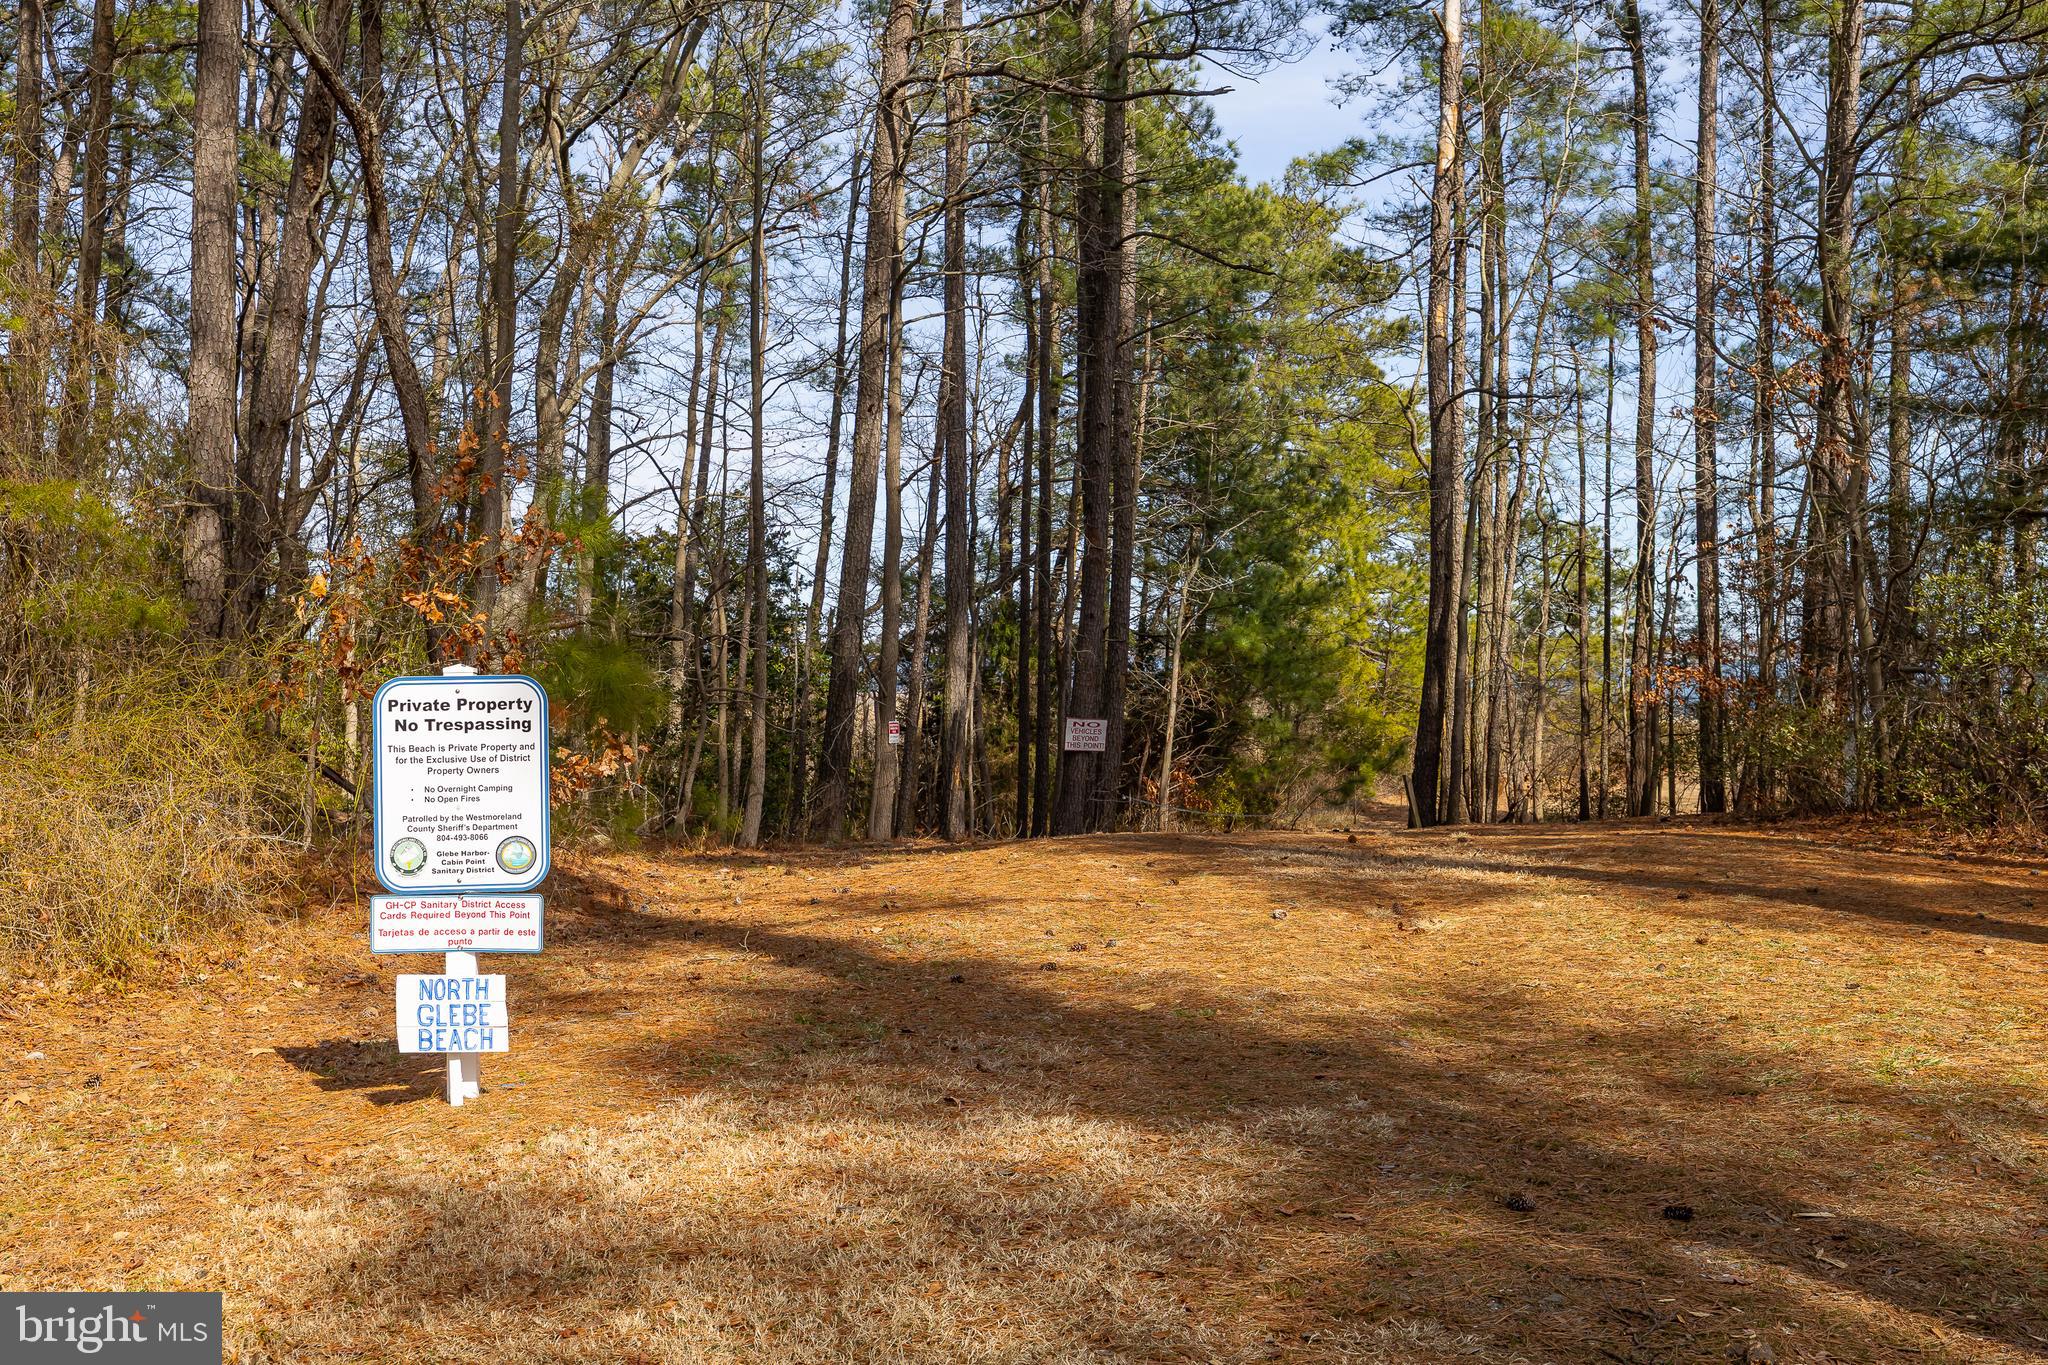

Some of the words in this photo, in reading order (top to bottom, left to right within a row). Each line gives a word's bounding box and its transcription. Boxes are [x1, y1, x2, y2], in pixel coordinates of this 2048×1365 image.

[388, 699, 450, 712] Private
[457, 698, 532, 713] Property
[395, 720, 418, 732] No
[425, 718, 532, 733] Trespassing
[388, 745, 406, 753] This
[409, 744, 435, 752] Beach
[438, 744, 445, 752] is
[448, 744, 478, 752] Private
[481, 743, 517, 753] Property
[520, 743, 535, 751] and
[395, 756, 407, 764] for
[410, 756, 423, 764] the
[427, 755, 467, 763] Exclusive
[470, 755, 487, 763] Use
[500, 754, 530, 762] District
[428, 767, 464, 775] Property
[467, 766, 499, 774] Owners
[437, 785, 476, 794] Overnight
[478, 785, 513, 793] Camping
[438, 796, 458, 804] Open
[403, 815, 437, 823] Patrolled
[466, 813, 522, 821] Westmoreland
[407, 825, 435, 833] County
[495, 901, 525, 909] Access
[411, 912, 450, 920] Required
[455, 911, 486, 919] Beyond
[510, 911, 530, 919] Point
[378, 929, 414, 937] Tarjetas
[478, 928, 500, 936] partir
[419, 978, 489, 1000] NORTH
[417, 1004, 491, 1027] GLEBE
[419, 1028, 493, 1051] BEACH
